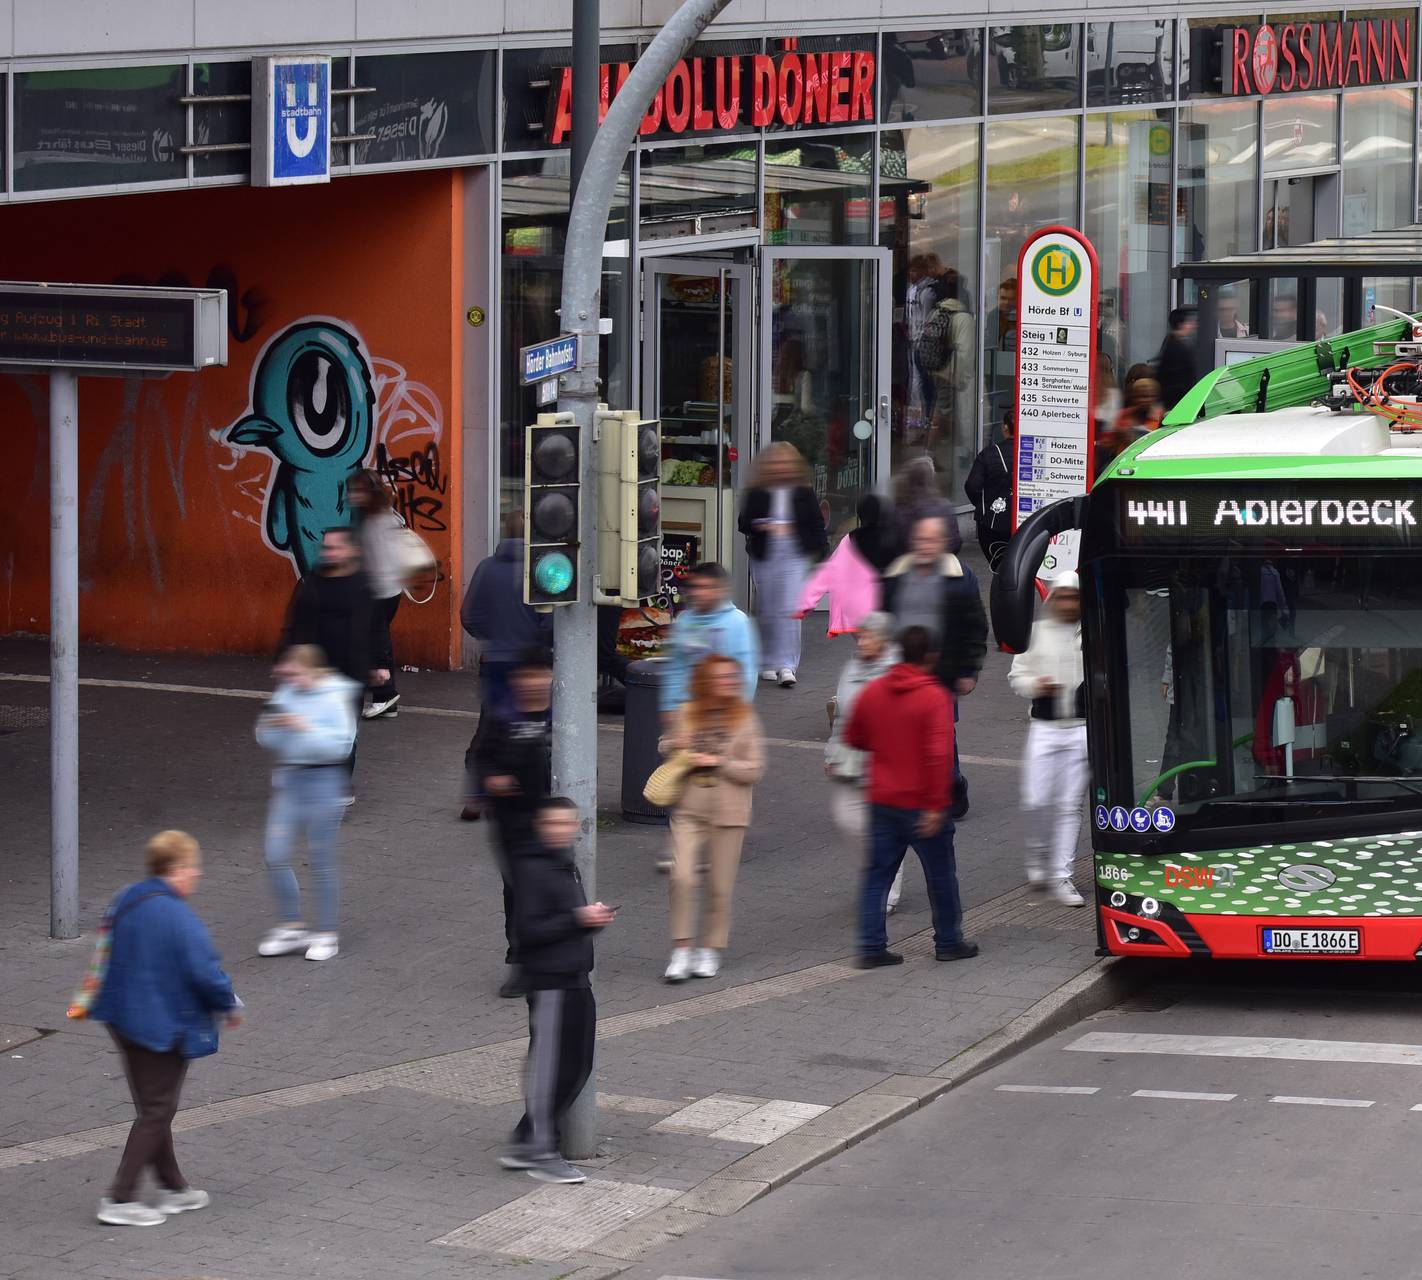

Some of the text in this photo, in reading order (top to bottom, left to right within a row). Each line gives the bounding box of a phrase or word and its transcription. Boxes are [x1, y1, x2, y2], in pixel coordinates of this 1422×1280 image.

[1233, 18, 1410, 95] ROSSMANN
[753, 37, 875, 126] DÖNER
[281, 106, 322, 118] stadtbahn
[1028, 305, 1056, 315] Hörde
[1059, 307, 1070, 315] Bf
[110, 315, 146, 328] Stadt
[1022, 330, 1053, 341] Steig 1
[1021, 347, 1039, 356] 432
[1021, 362, 1078, 373] 433 Sommerberg
[1021, 377, 1039, 386] 434
[1041, 383, 1071, 391] Schwerter
[1020, 393, 1079, 404] 435 Schwerte
[1021, 408, 1080, 419] 440 Aplerbeck
[1050, 441, 1077, 450] Holzen
[1050, 456, 1084, 465] DO-Mitte
[1050, 471, 1085, 481] Schwerte
[1099, 865, 1129, 881] 1866
[1274, 932, 1291, 948] DO
